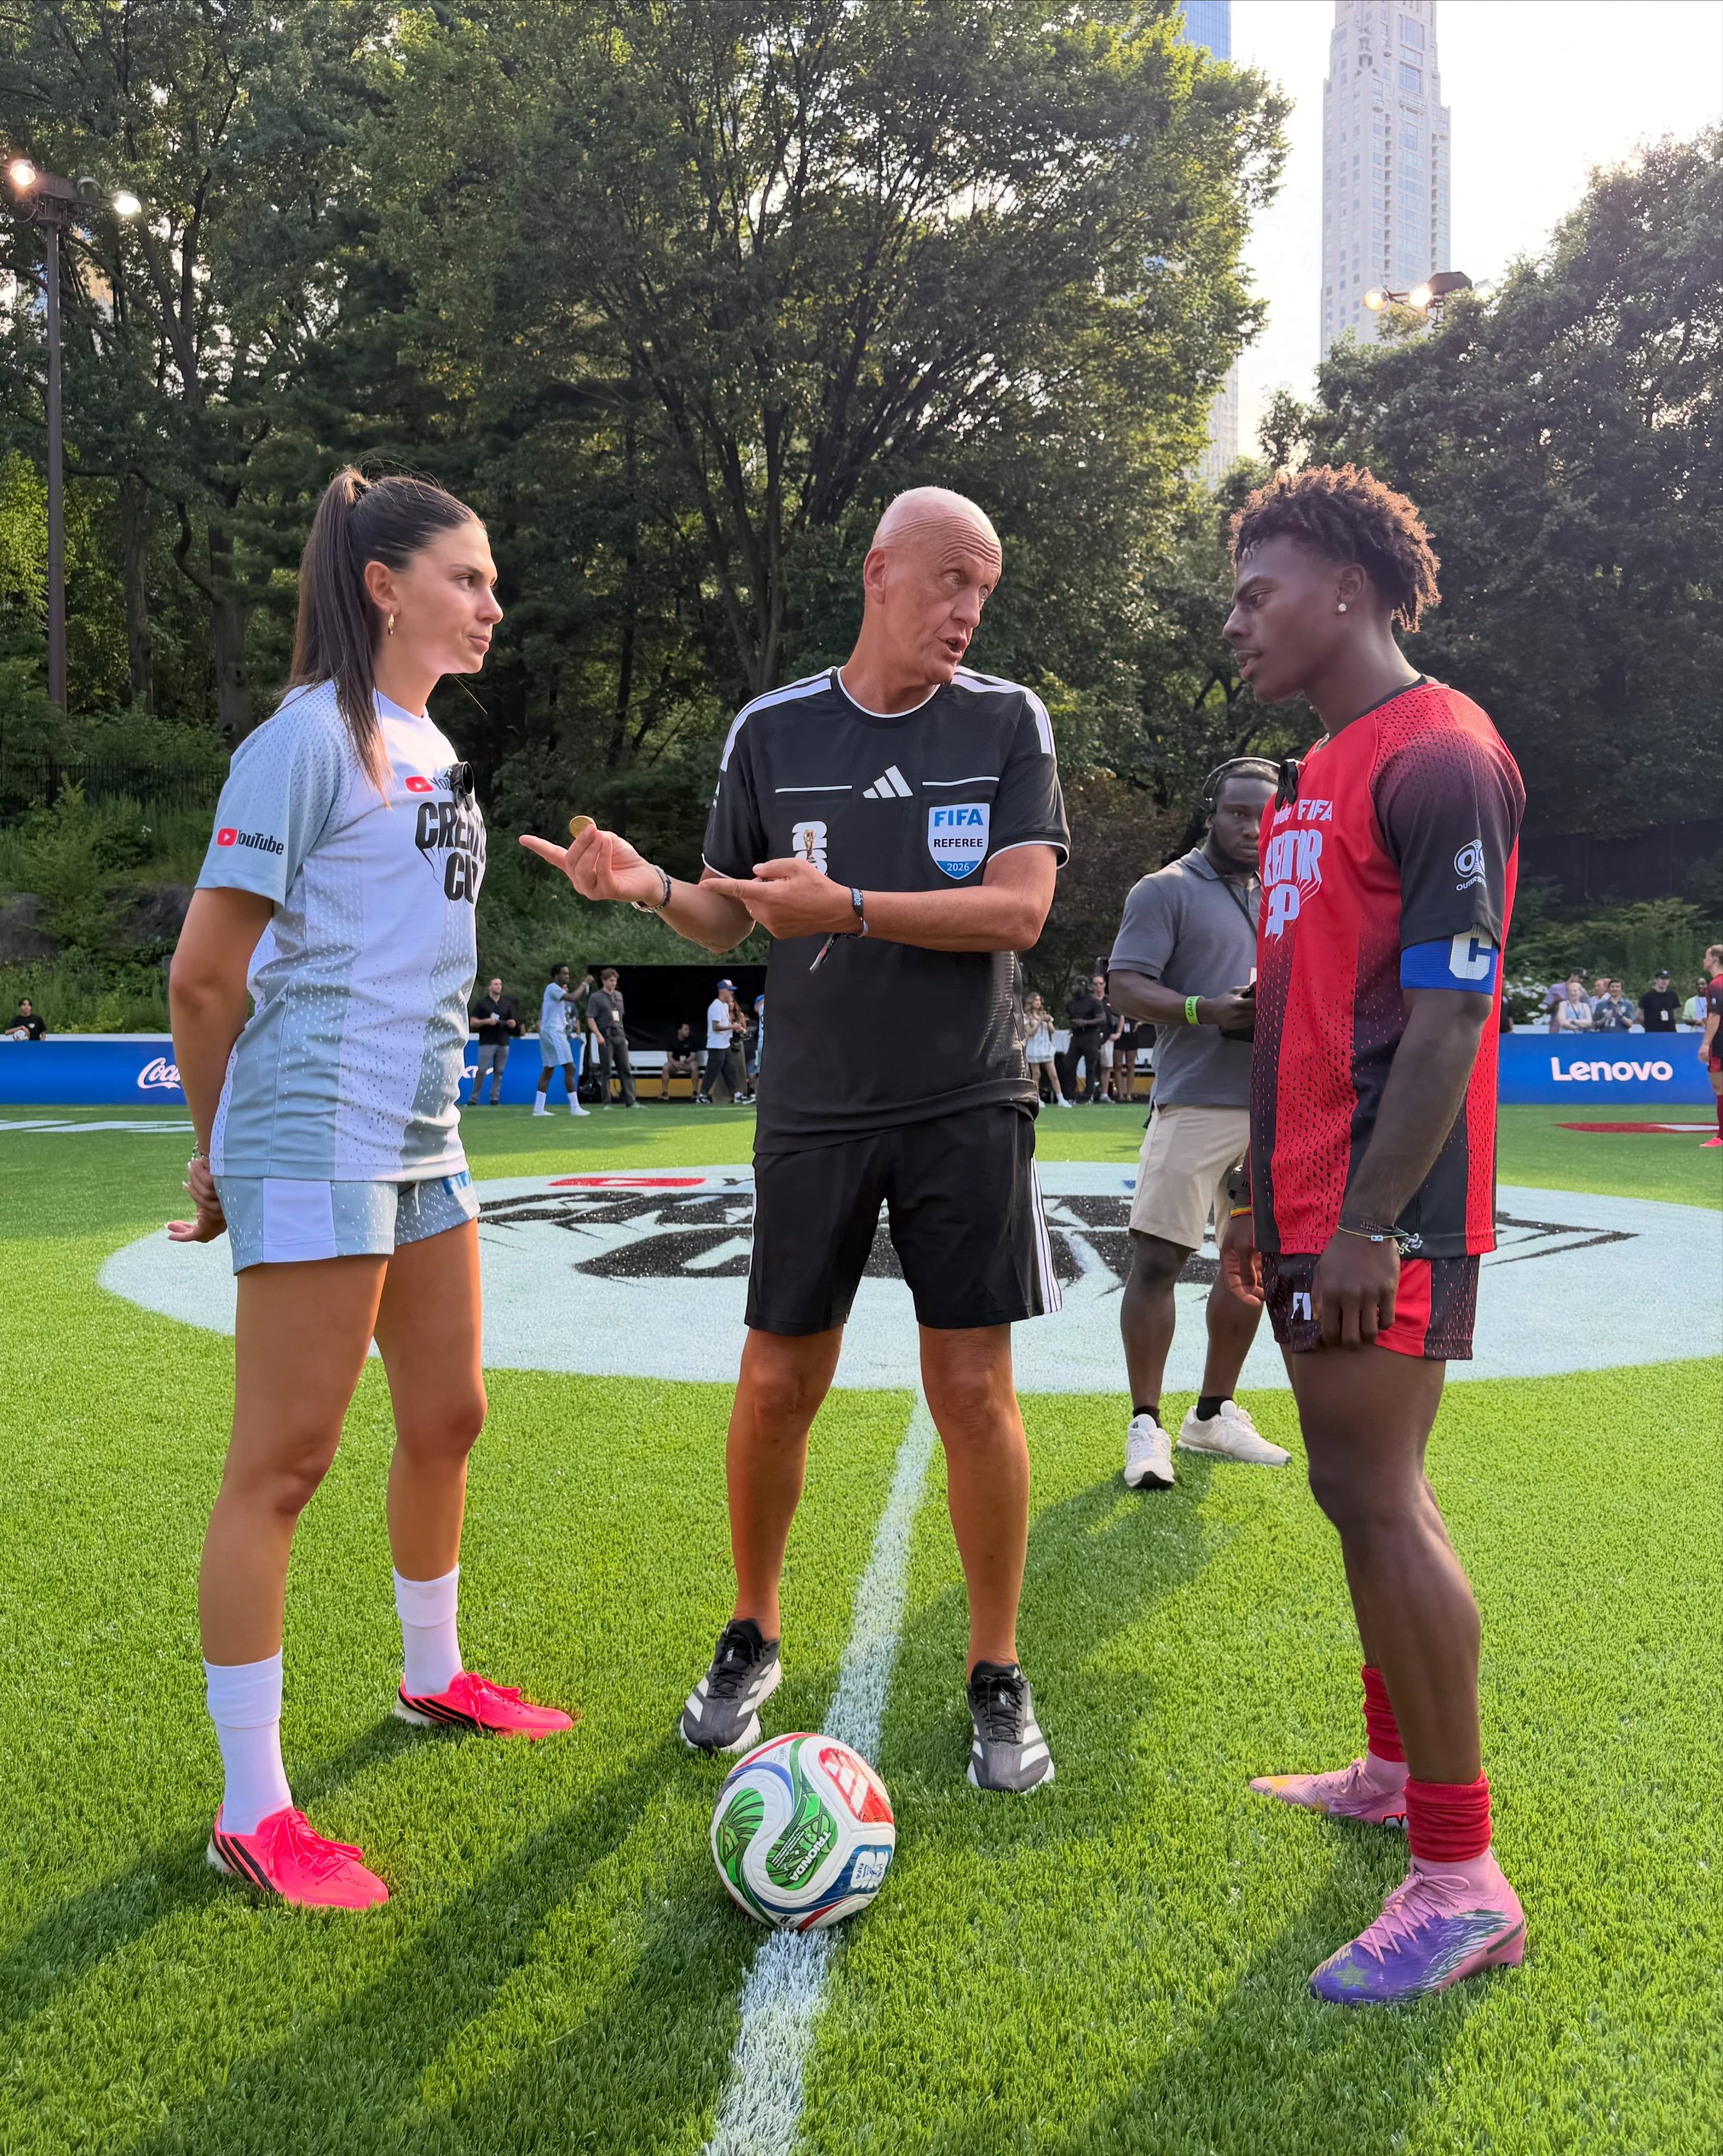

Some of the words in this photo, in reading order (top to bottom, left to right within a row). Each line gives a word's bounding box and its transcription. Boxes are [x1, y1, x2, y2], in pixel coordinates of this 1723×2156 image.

[934, 808, 984, 827] FIFA
[934, 839, 983, 847] REFEREE
[947, 863, 970, 872] 2026
[1449, 924, 1493, 981] C
[138, 1057, 181, 1089] Coca
[1550, 1056, 1674, 1081] Lenovo
[789, 1830, 832, 1881] TRIONDA
[855, 1863, 864, 1879] FIFA
